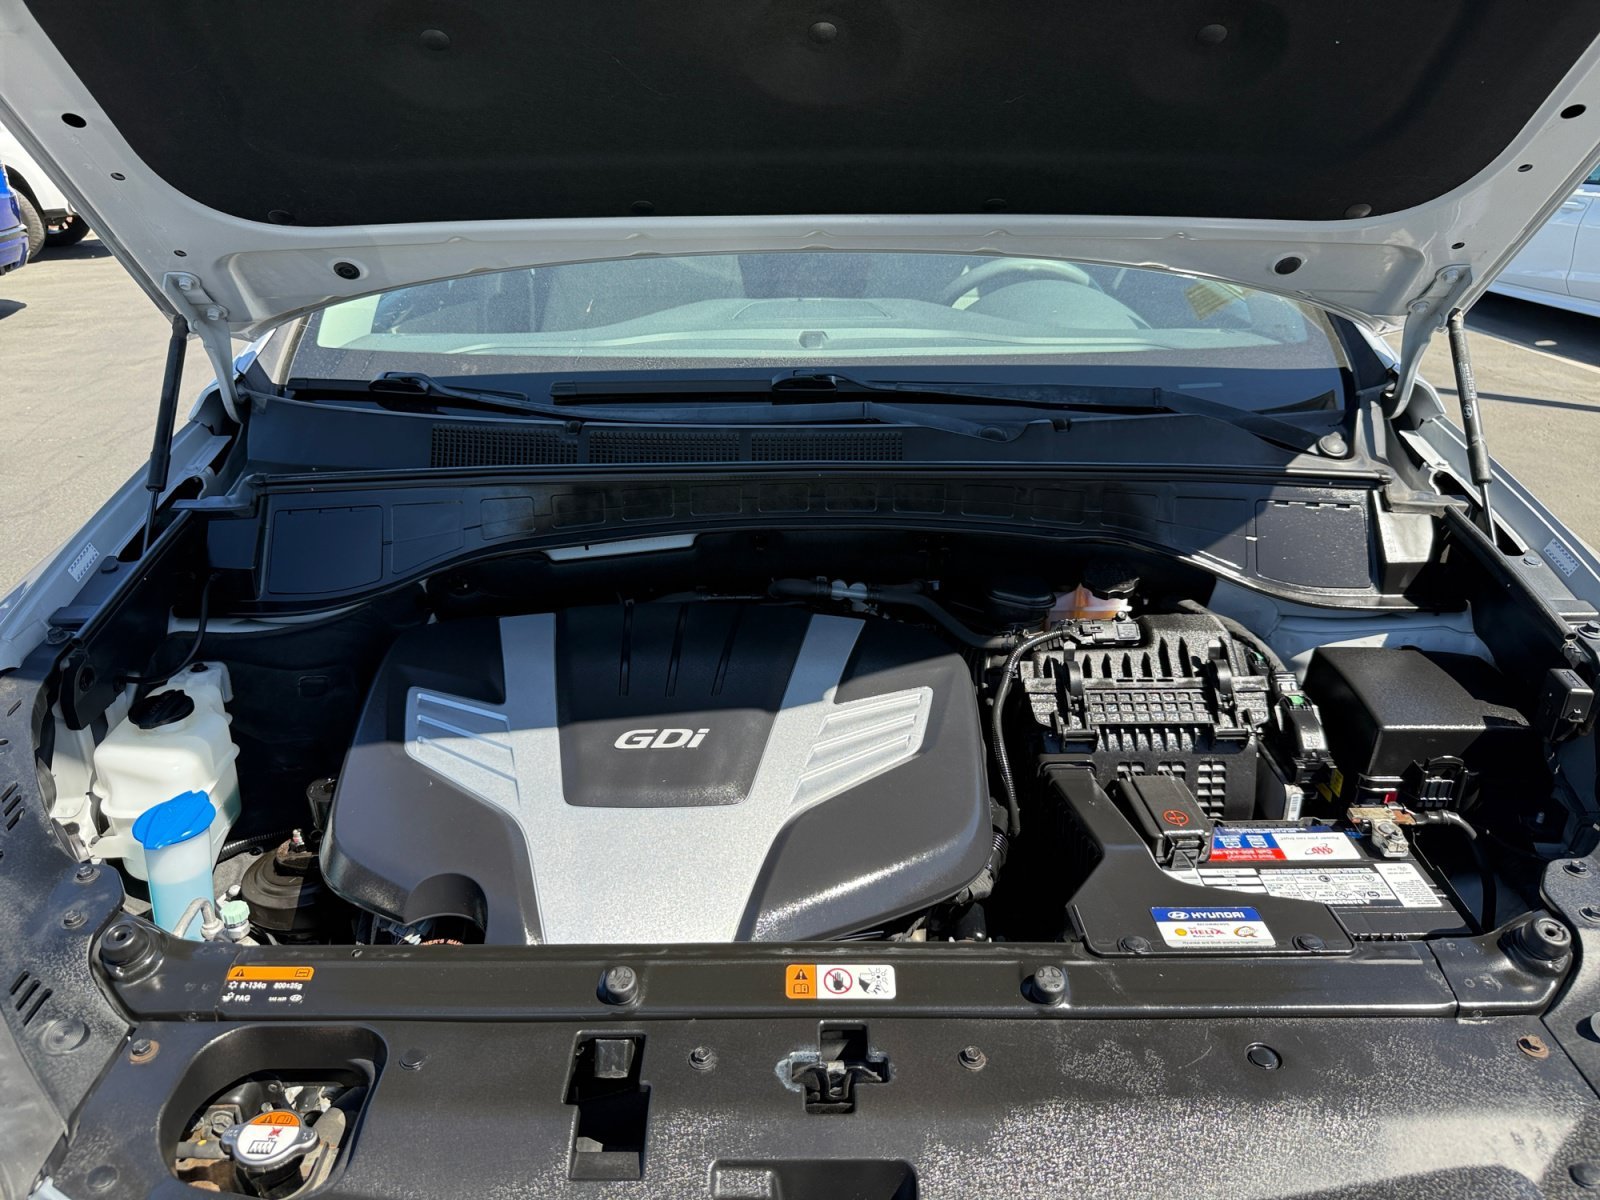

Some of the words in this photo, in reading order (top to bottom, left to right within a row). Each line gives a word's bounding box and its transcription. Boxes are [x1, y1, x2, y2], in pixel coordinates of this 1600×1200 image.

[614, 728, 710, 749] GDi
[1191, 911, 1245, 919] HYUNDAI
[1190, 927, 1225, 935] HELIX
